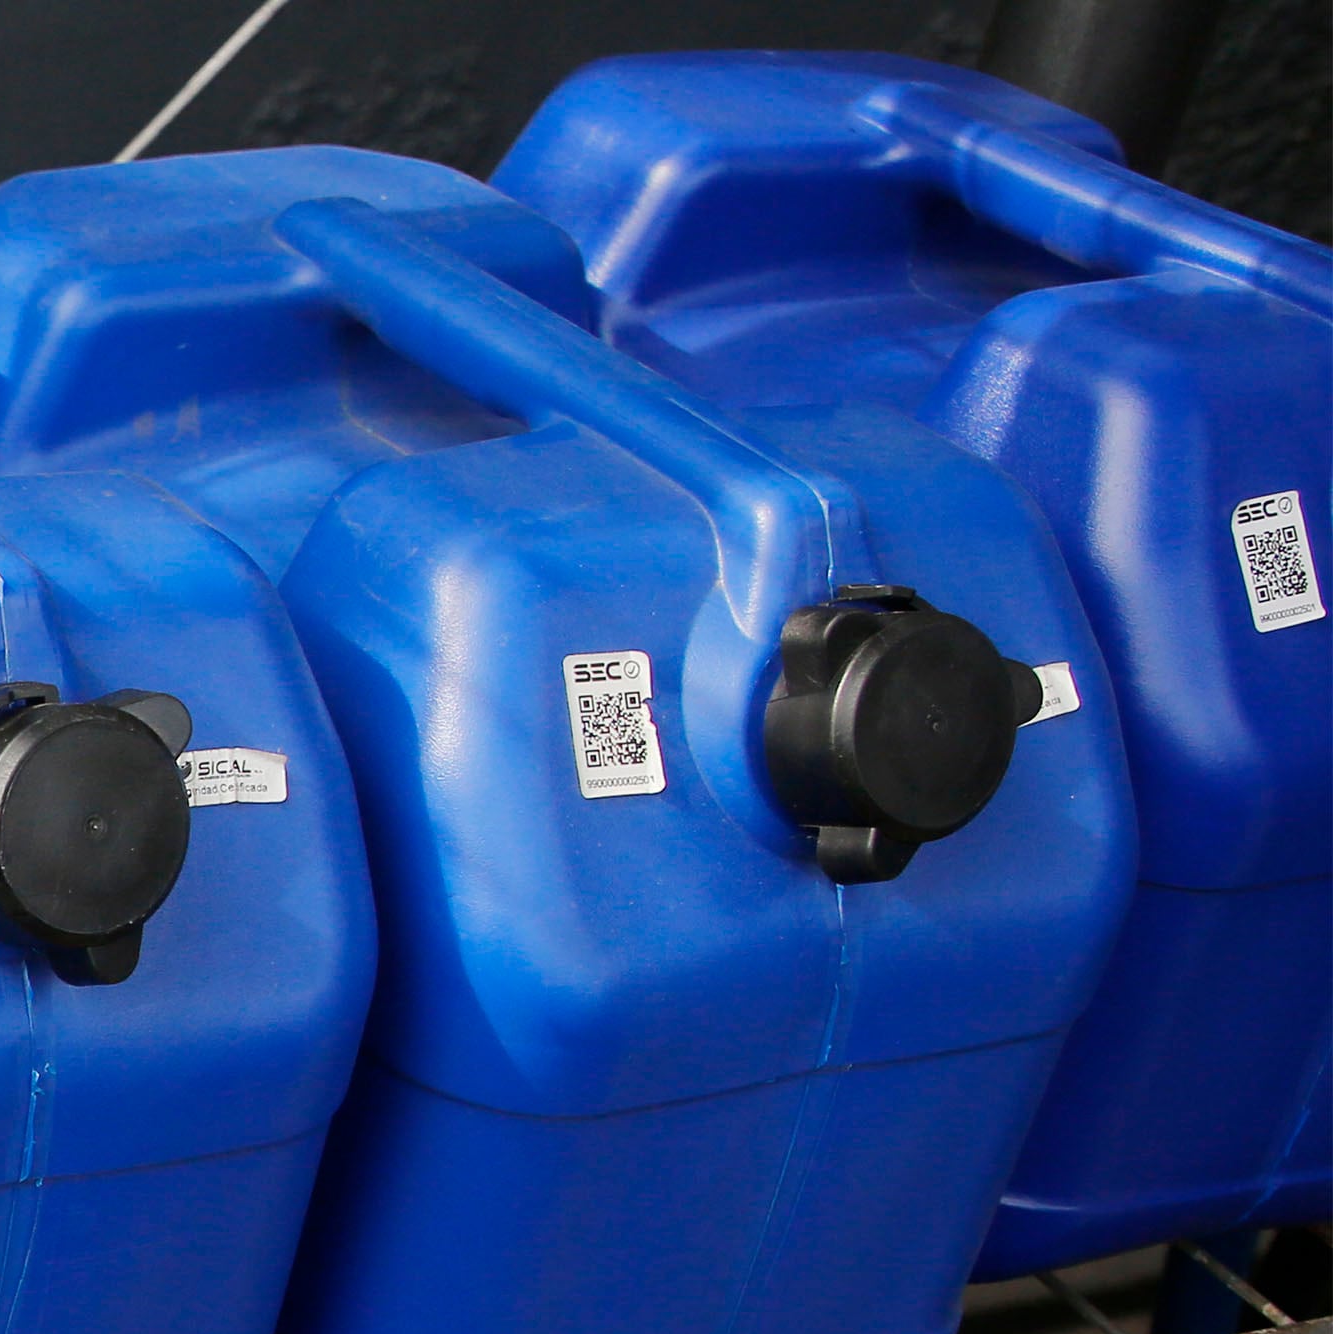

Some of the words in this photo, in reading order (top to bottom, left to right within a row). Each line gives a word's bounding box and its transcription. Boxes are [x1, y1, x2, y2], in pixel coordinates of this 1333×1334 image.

[1237, 499, 1278, 524] SEC
[573, 661, 622, 682] SEC
[198, 760, 251, 776] SICAL
